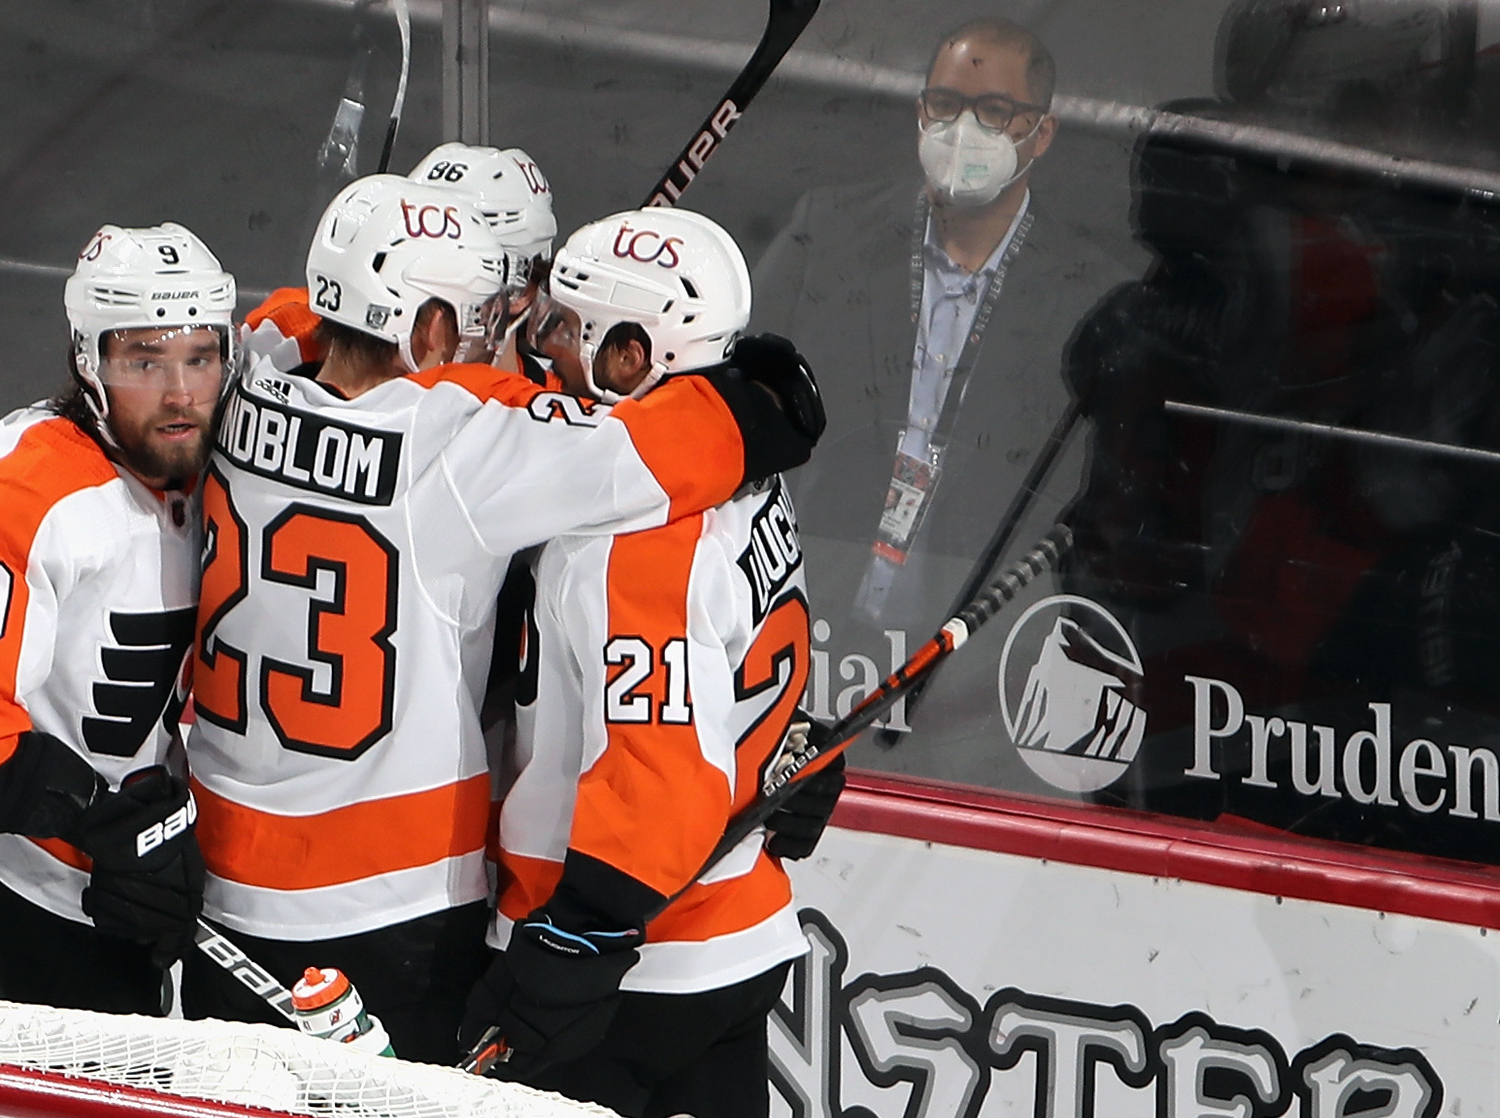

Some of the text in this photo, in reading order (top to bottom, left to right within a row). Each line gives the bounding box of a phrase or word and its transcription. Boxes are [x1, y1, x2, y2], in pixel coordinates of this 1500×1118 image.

[427, 161, 469, 182] 86
[513, 156, 551, 195] tc
[400, 198, 462, 240] tcs
[157, 244, 180, 265] 9
[612, 220, 684, 269] tcs
[316, 275, 342, 312] 23
[975, 304, 993, 333] NEW
[193, 457, 400, 762] 23
[603, 635, 693, 725] 21
[802, 618, 913, 733] ial
[1184, 674, 1500, 822] Pruden
